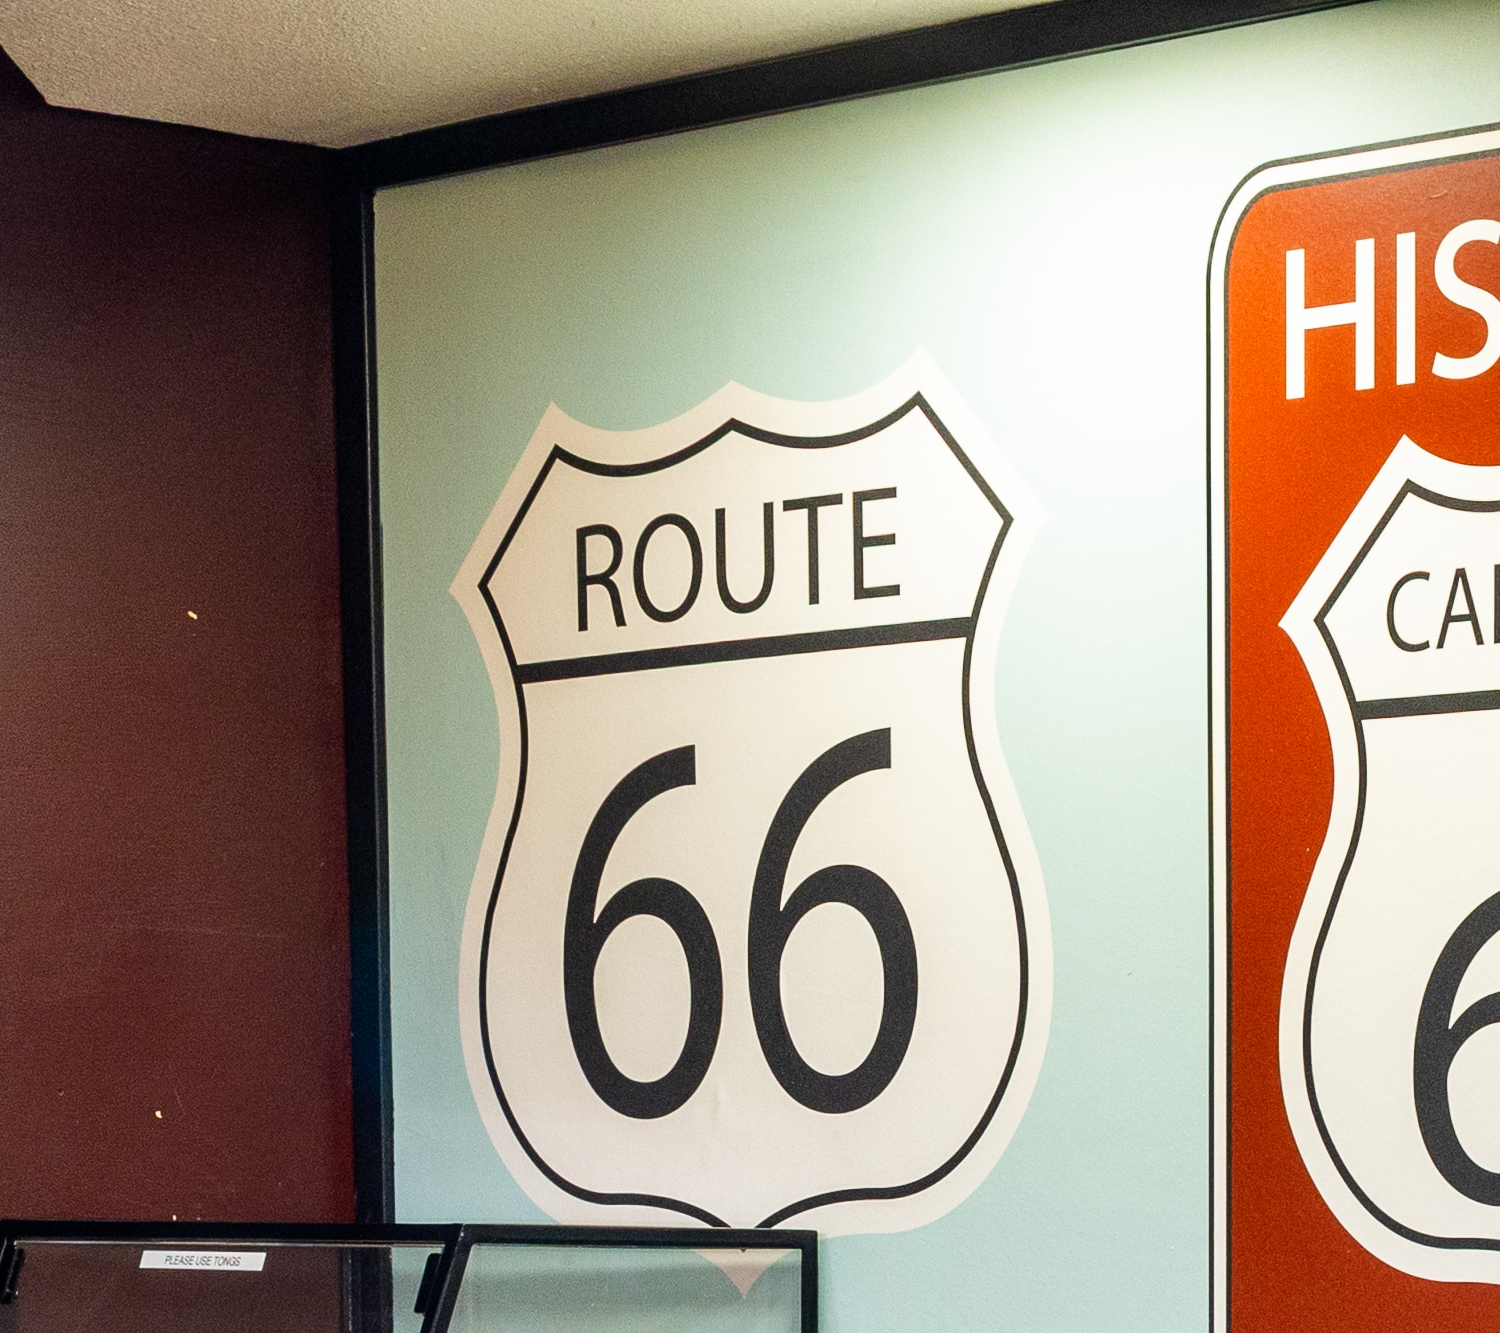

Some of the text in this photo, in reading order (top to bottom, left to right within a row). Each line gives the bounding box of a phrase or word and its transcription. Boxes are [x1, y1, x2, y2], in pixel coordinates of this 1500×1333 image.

[576, 487, 901, 632] ROUTE
[563, 728, 918, 1119] 66
[164, 1255, 242, 1266] PLEASE USE TONGS
